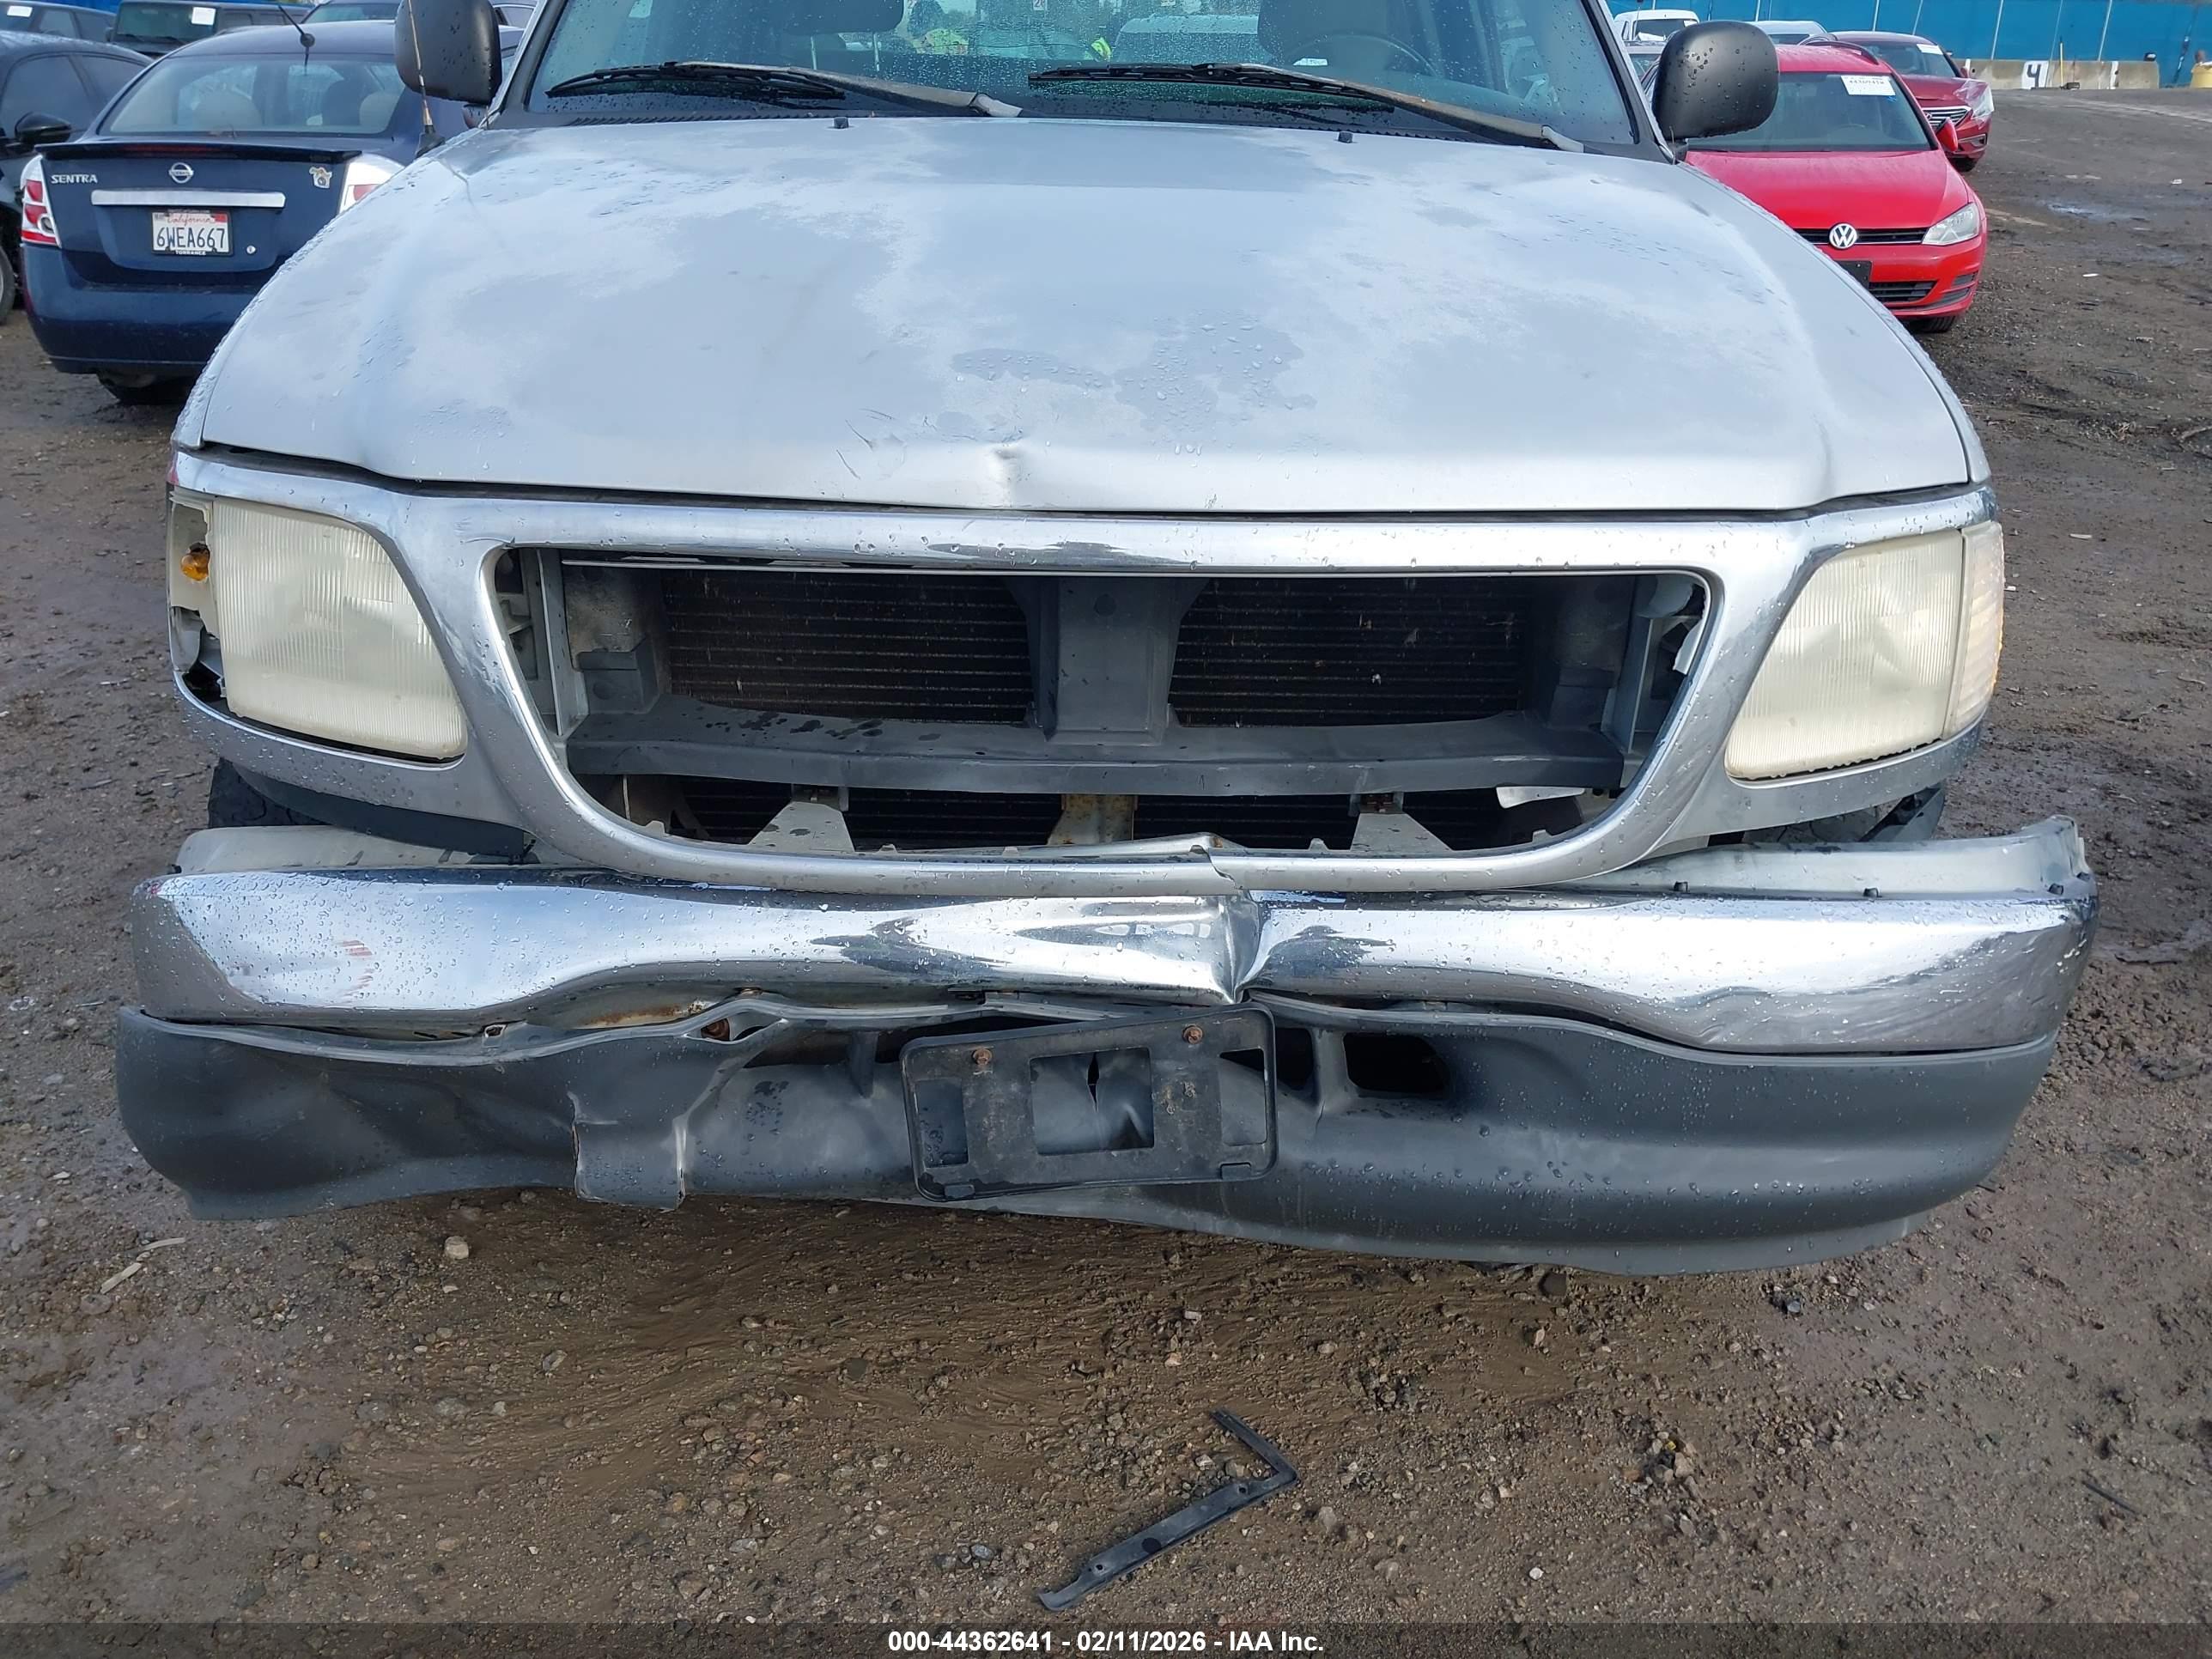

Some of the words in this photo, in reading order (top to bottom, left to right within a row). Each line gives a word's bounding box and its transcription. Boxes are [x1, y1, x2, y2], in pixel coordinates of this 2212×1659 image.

[2027, 64, 2042, 88] 4
[51, 173, 98, 185] SENTRA
[167, 213, 215, 227] California
[156, 227, 226, 249] 6WEA667
